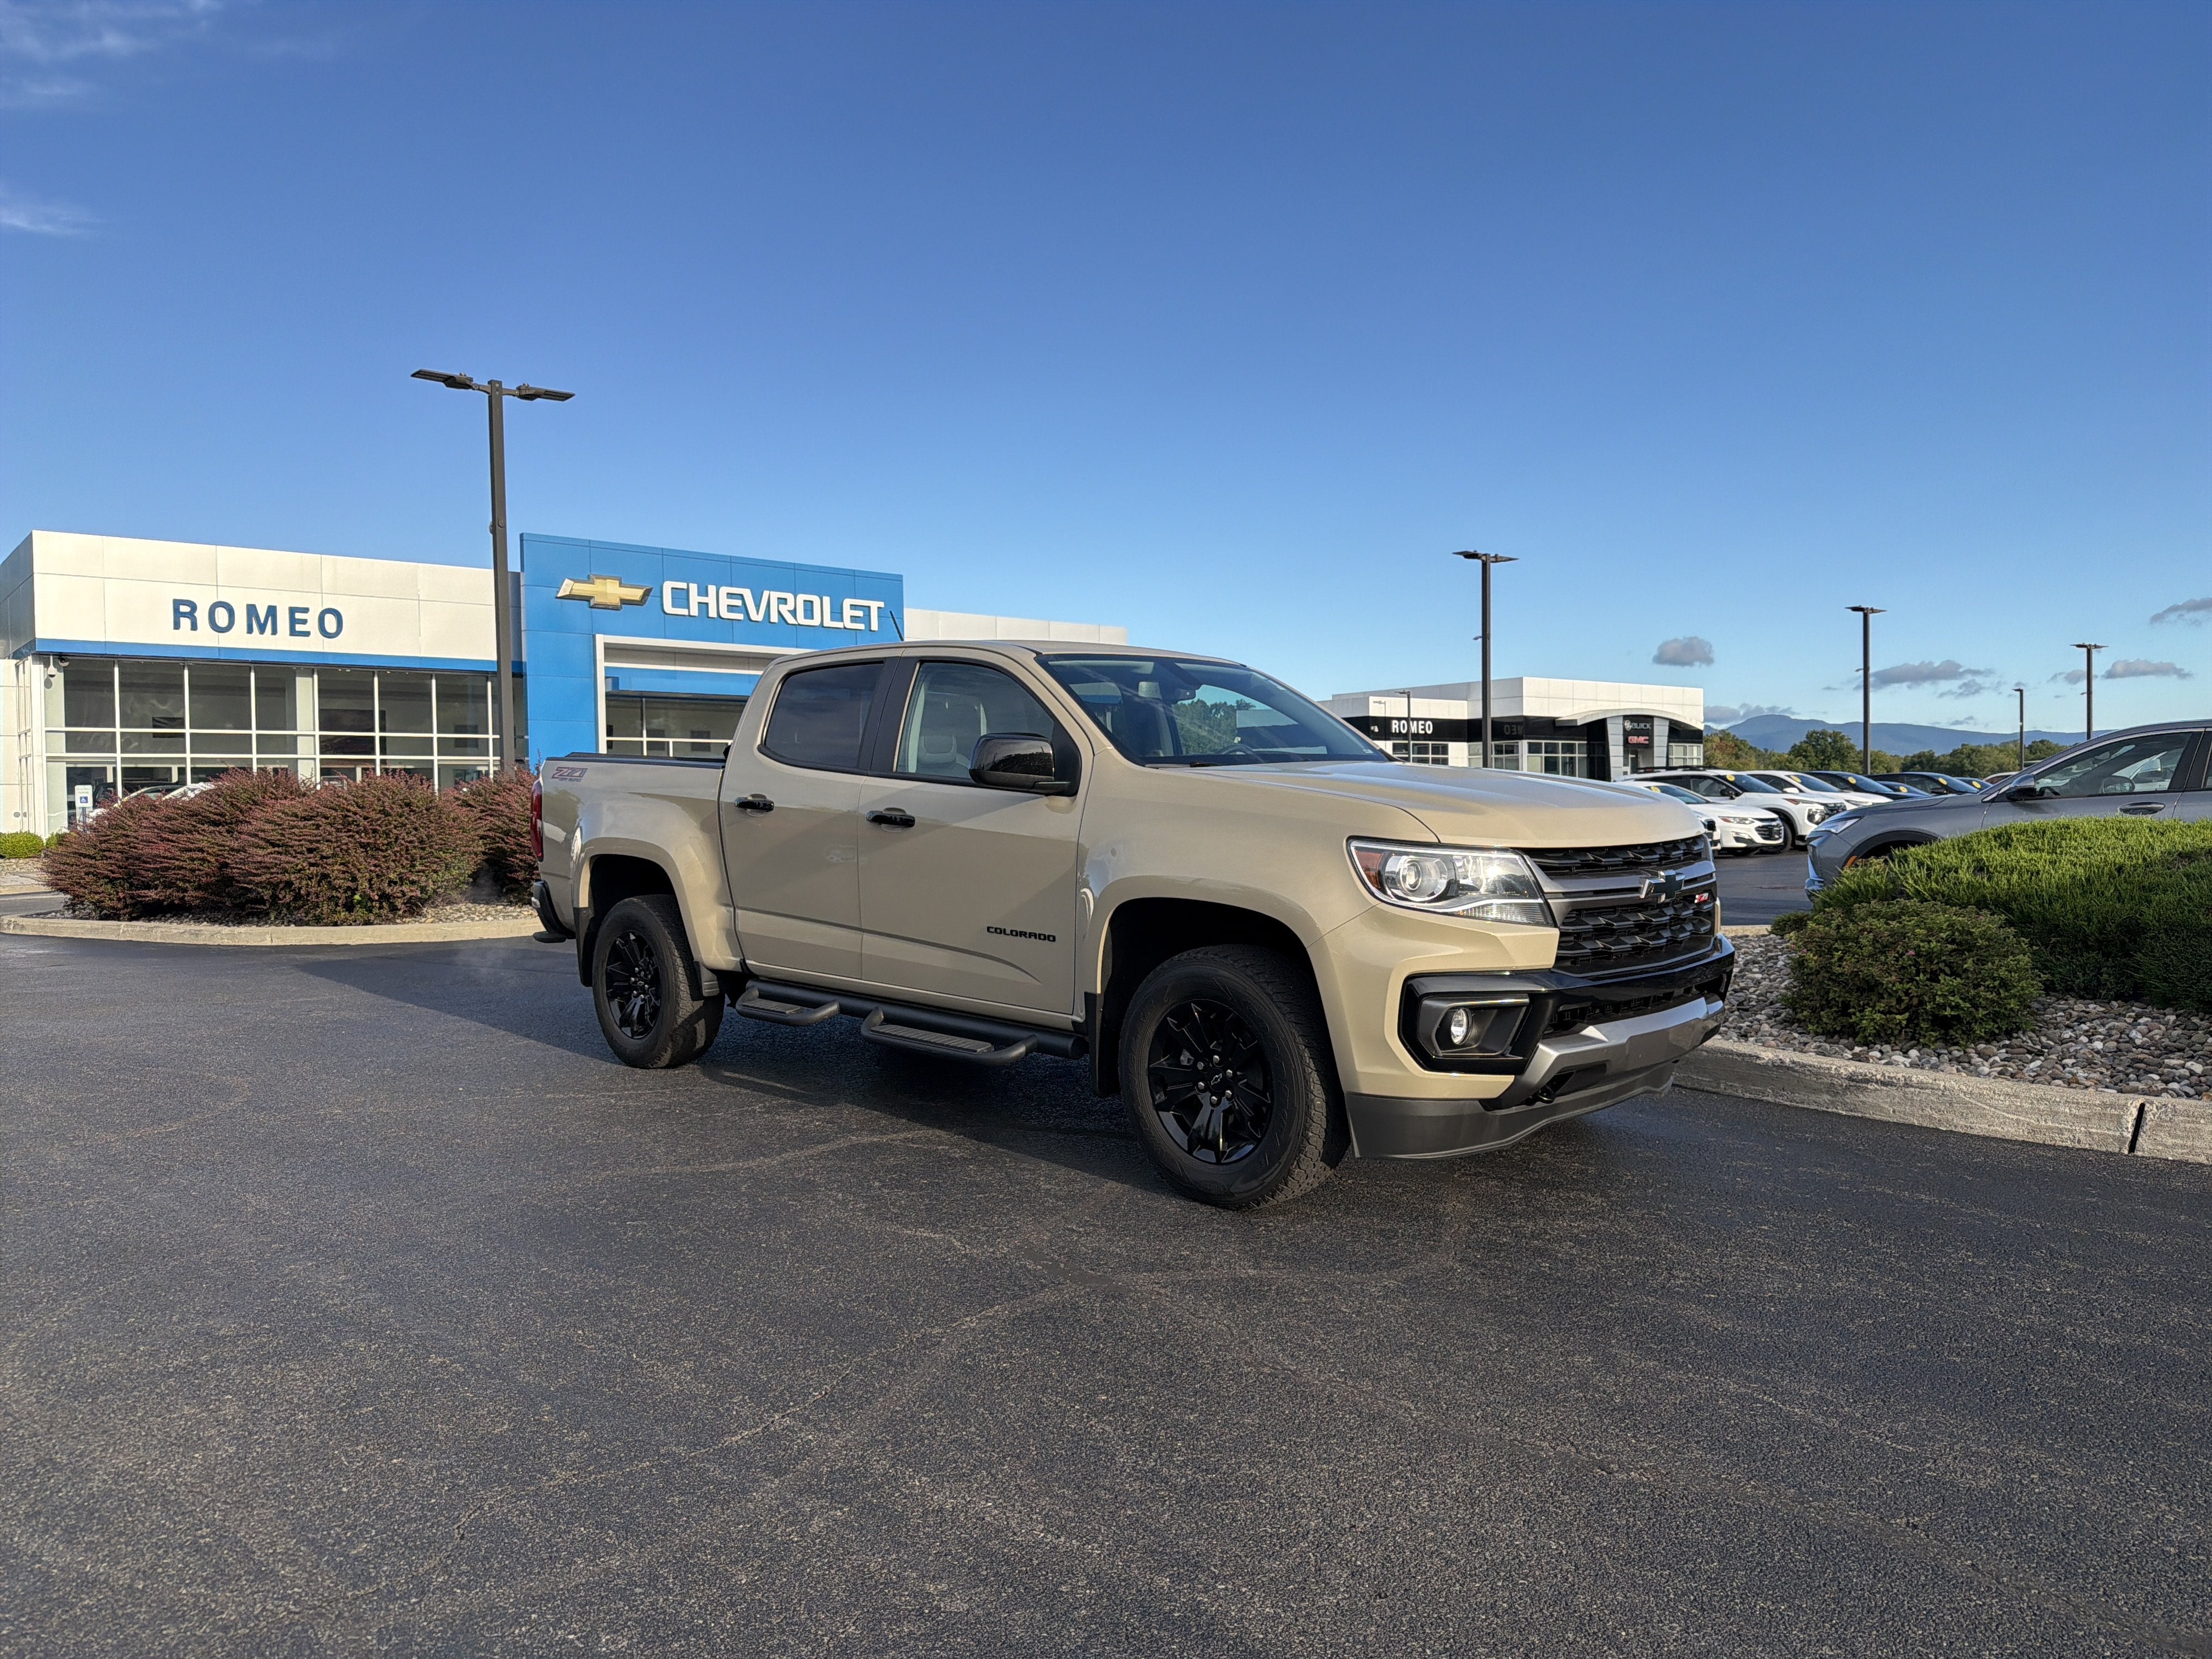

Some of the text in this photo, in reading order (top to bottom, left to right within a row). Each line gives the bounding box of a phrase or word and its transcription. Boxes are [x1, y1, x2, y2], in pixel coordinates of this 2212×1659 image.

[662, 580, 885, 632] CHEVROLET
[173, 599, 343, 639] ROMEO
[1391, 720, 1433, 734] ROMEO
[1628, 736, 1649, 744] GMC
[551, 766, 588, 778] Z71
[986, 926, 1056, 943] COLORADO
